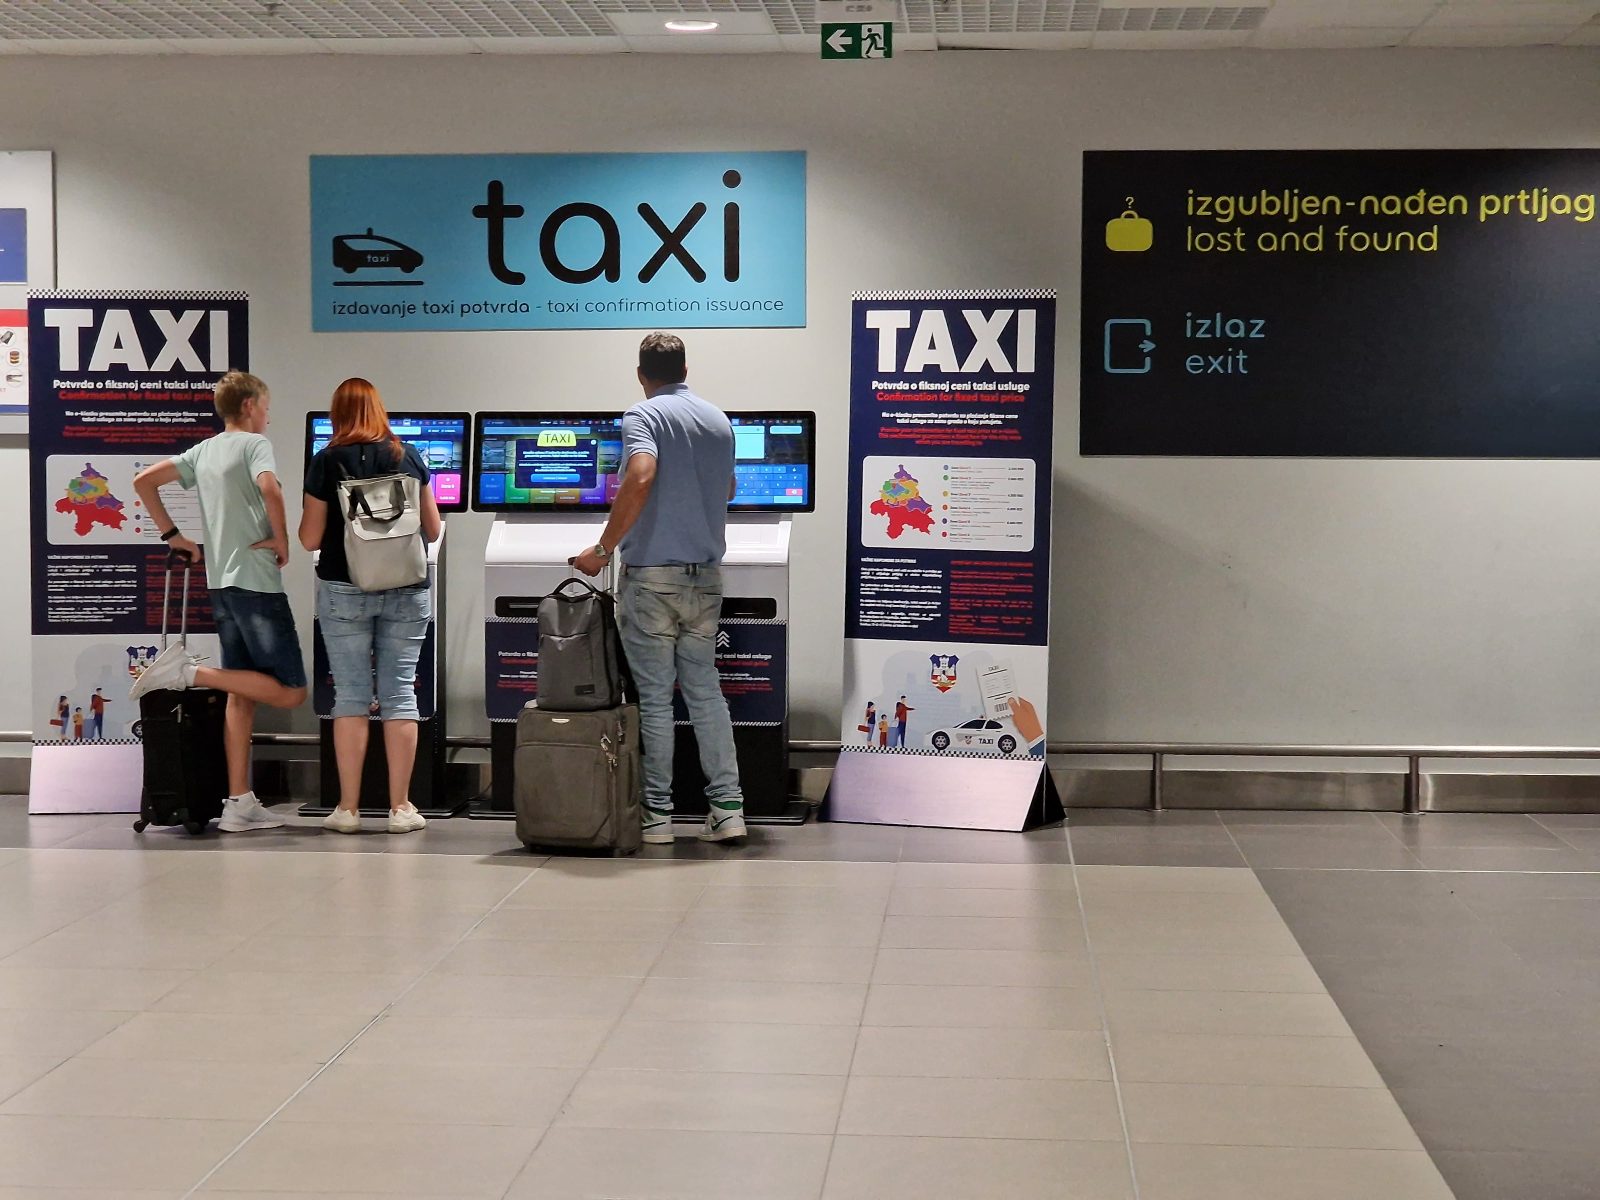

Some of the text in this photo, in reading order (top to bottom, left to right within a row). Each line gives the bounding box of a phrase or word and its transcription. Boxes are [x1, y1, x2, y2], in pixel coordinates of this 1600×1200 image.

[1186, 188, 1597, 222] izgubljen-nađen prtljag
[472, 169, 741, 286] taxi
[1186, 225, 1440, 252] lost and found
[366, 253, 390, 263] taxi
[332, 300, 417, 318] izdavanje
[422, 299, 455, 315] taxi
[460, 299, 530, 318] potvrda
[547, 298, 579, 313] taxi
[584, 297, 700, 313] confirmation
[706, 297, 784, 312] issuance
[1184, 311, 1267, 339] izlaz
[44, 308, 229, 372] TAXI
[866, 309, 1036, 373] TAXI
[1185, 347, 1249, 375] exit
[53, 379, 95, 389] Potvrda
[105, 379, 139, 391] fiksnoj
[140, 380, 162, 389] ceni
[163, 380, 189, 389] taksi
[190, 380, 216, 391] uslug
[871, 380, 1031, 393] Potvrda o fiksnoj ceni taksi usluge
[876, 391, 937, 402] Confirmation
[544, 432, 571, 444] TAXI
